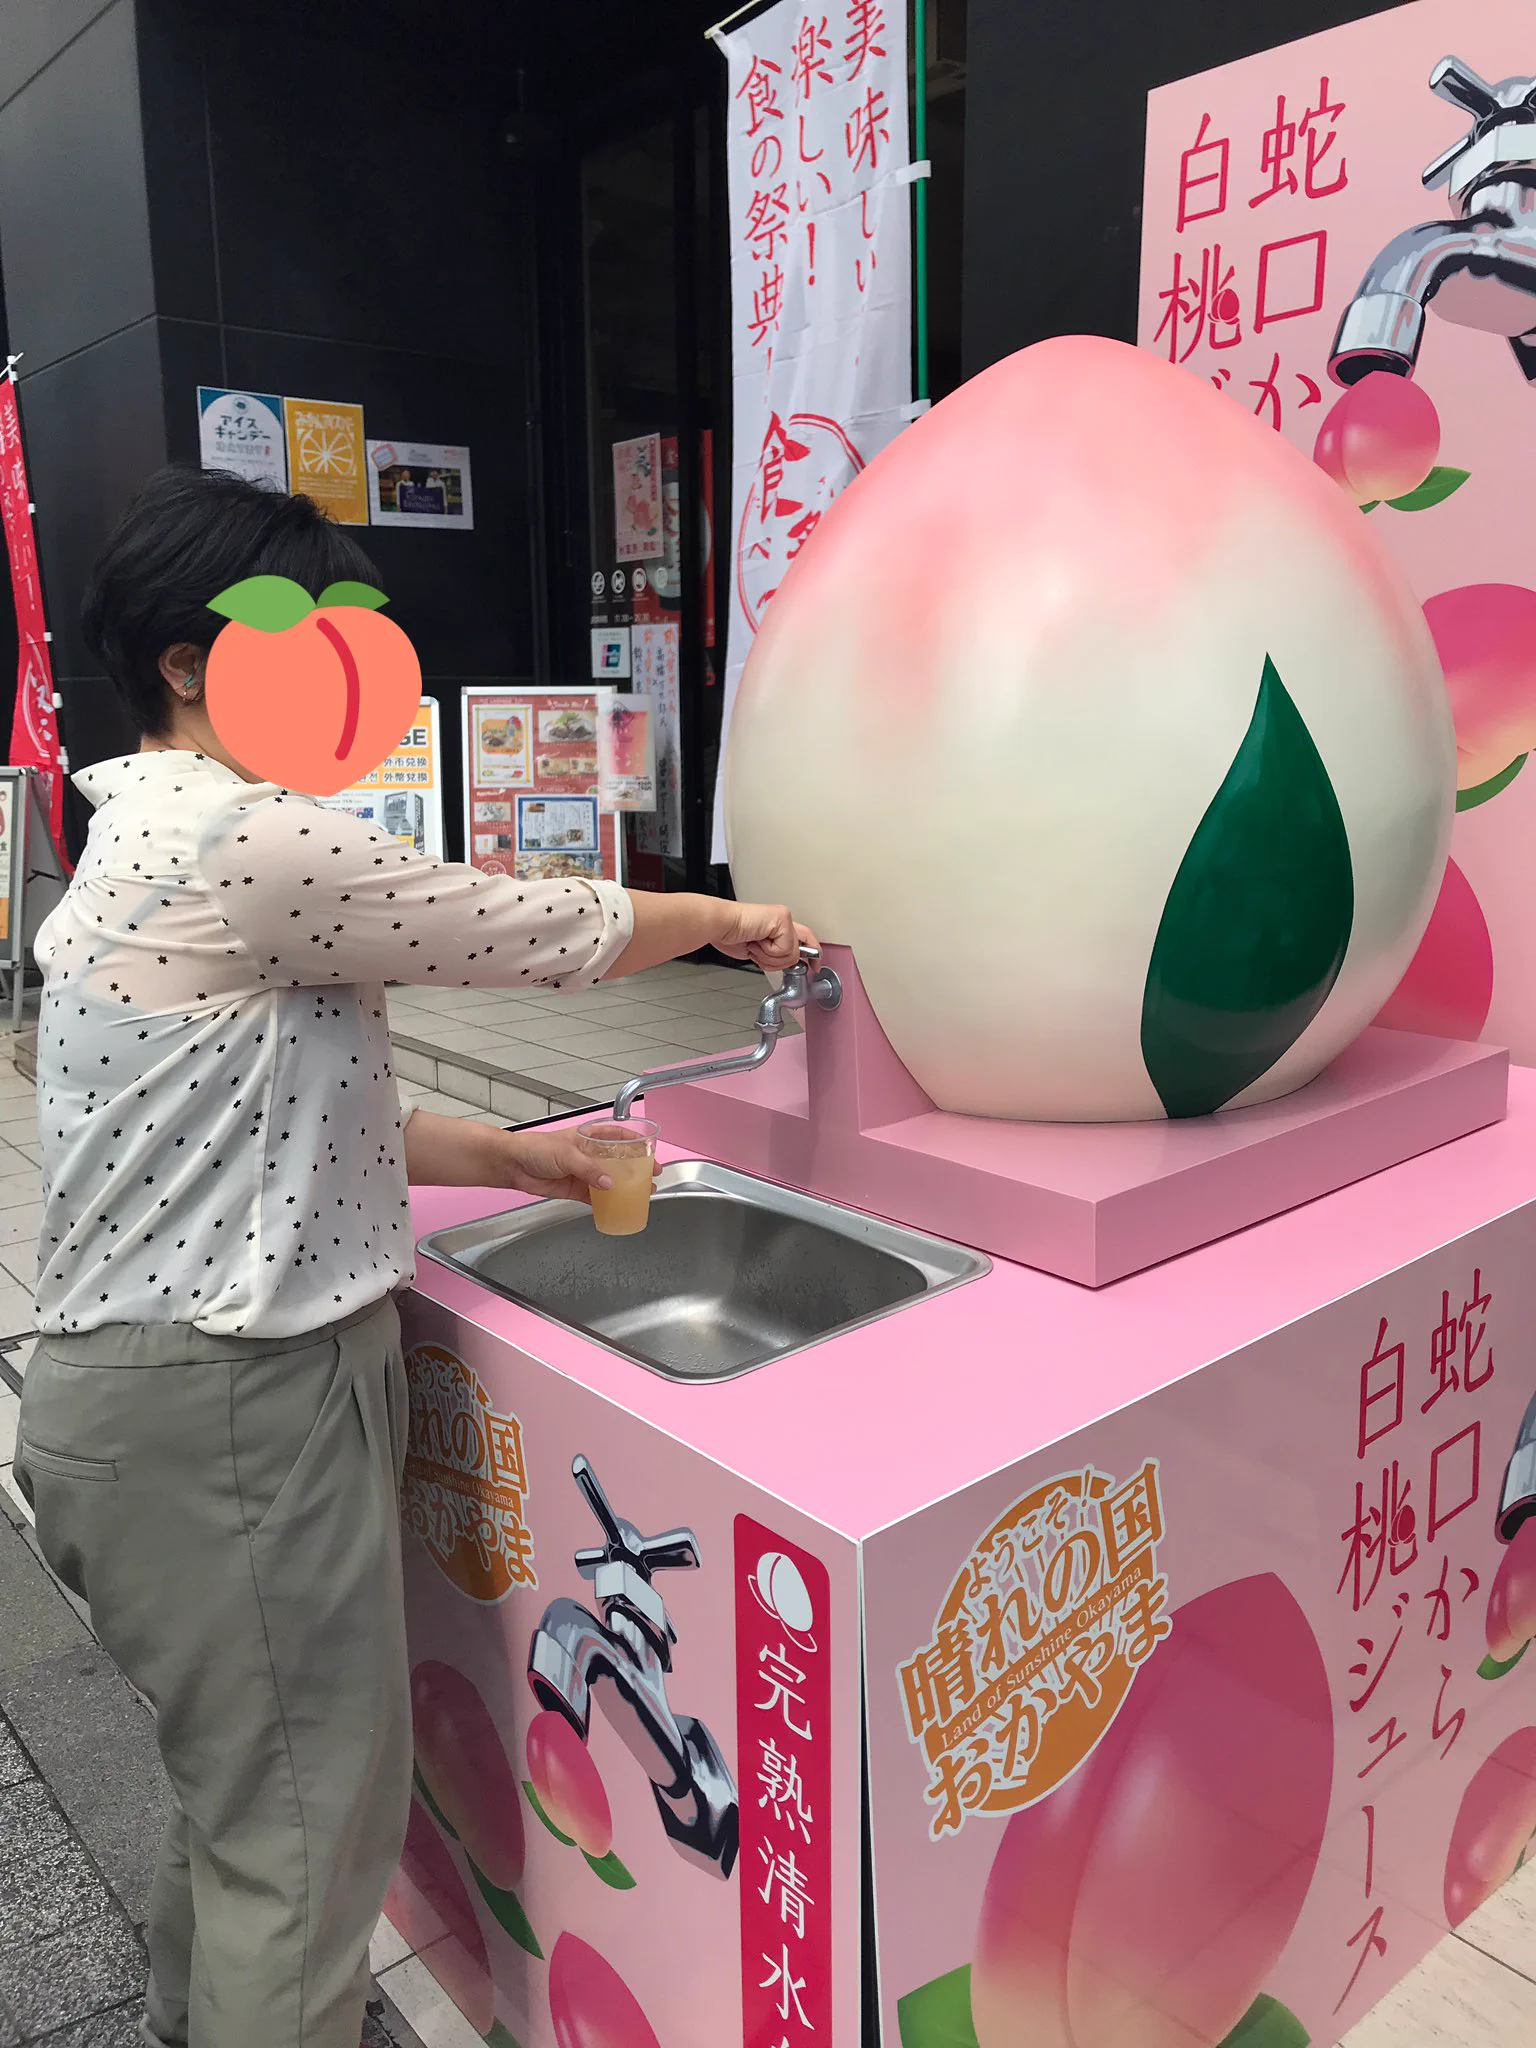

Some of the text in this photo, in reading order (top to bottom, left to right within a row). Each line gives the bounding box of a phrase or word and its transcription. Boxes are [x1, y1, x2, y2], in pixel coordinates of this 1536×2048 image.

[1153, 112, 1242, 390] 白桃
[220, 414, 258, 430] アイス
[409, 1400, 527, 1495] れの国
[472, 1480, 514, 1508] Okayama
[968, 1469, 1092, 1597] ようこそ!
[1420, 1267, 1495, 1761] 蛇口から
[900, 1463, 1162, 1735] 晴れの国
[928, 1577, 1170, 1835] おかやま
[941, 1566, 1142, 1749] Land of Sunshine Okayama
[1331, 1316, 1419, 2017] 白桃ジュース
[753, 1641, 816, 2048] 完熟清水
